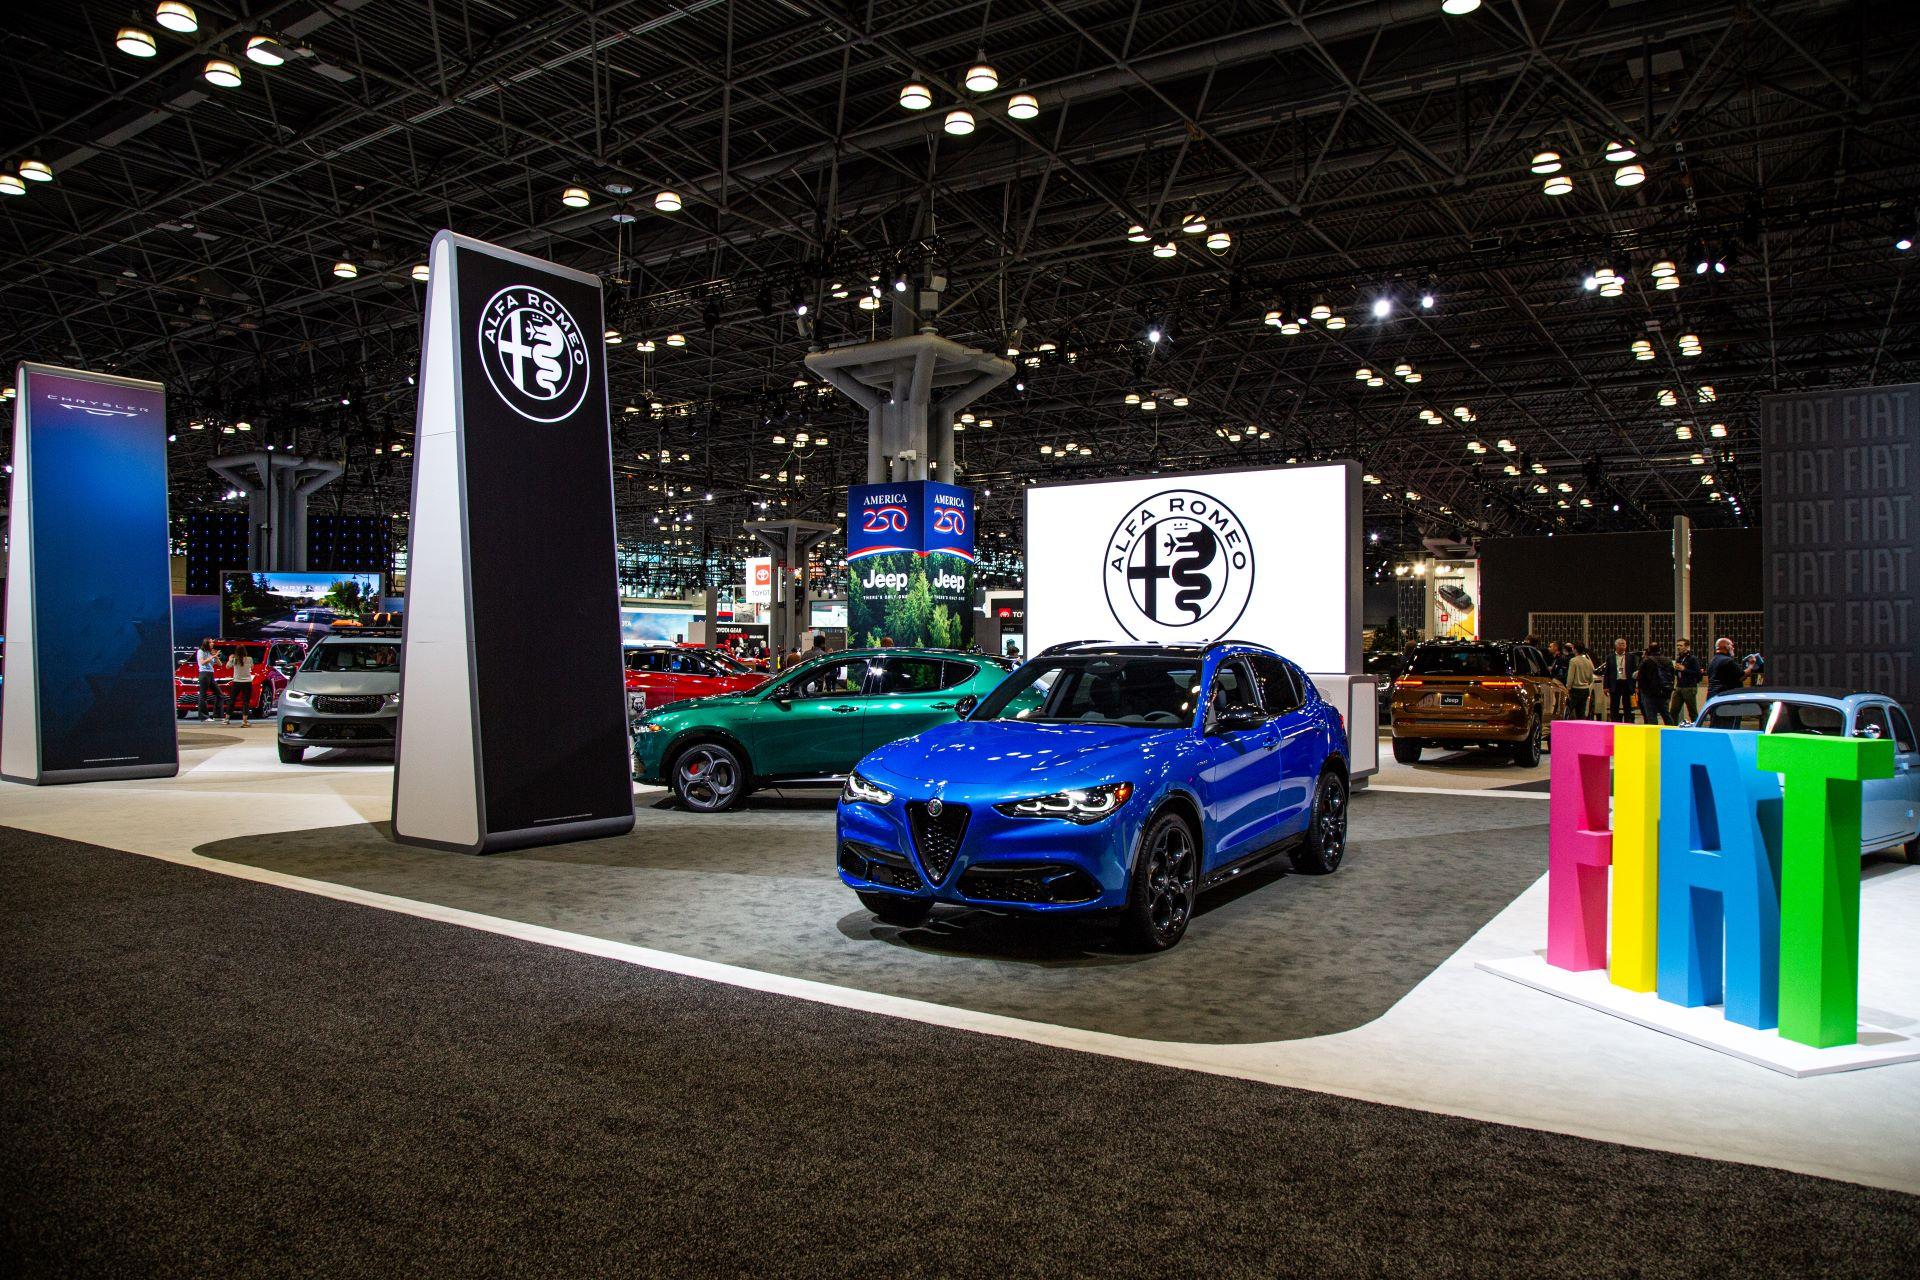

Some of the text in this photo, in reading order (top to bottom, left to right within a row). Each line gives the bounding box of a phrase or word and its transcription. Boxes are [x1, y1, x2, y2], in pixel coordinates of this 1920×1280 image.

[485, 292, 584, 365] ALFA ROMEO
[47, 394, 149, 412] CHRYSLER
[1769, 391, 1911, 444] FIAT FIAT
[1769, 443, 1911, 495] FIAT FIAT
[863, 494, 908, 506] AMERICA
[863, 505, 909, 532] 250
[934, 494, 965, 508] AMERICA
[934, 506, 966, 536] 250
[1111, 498, 1246, 573] ALFA ROMEO
[1770, 495, 1912, 545] FIAT FIAT
[863, 569, 908, 592] Jeep
[934, 569, 965, 594] Jeep
[1772, 547, 1912, 596] FIAT FIAT
[752, 590, 772, 598] TOYOT
[1772, 600, 1913, 646] FIAT FIAT
[1547, 720, 1894, 1049] FIAT
